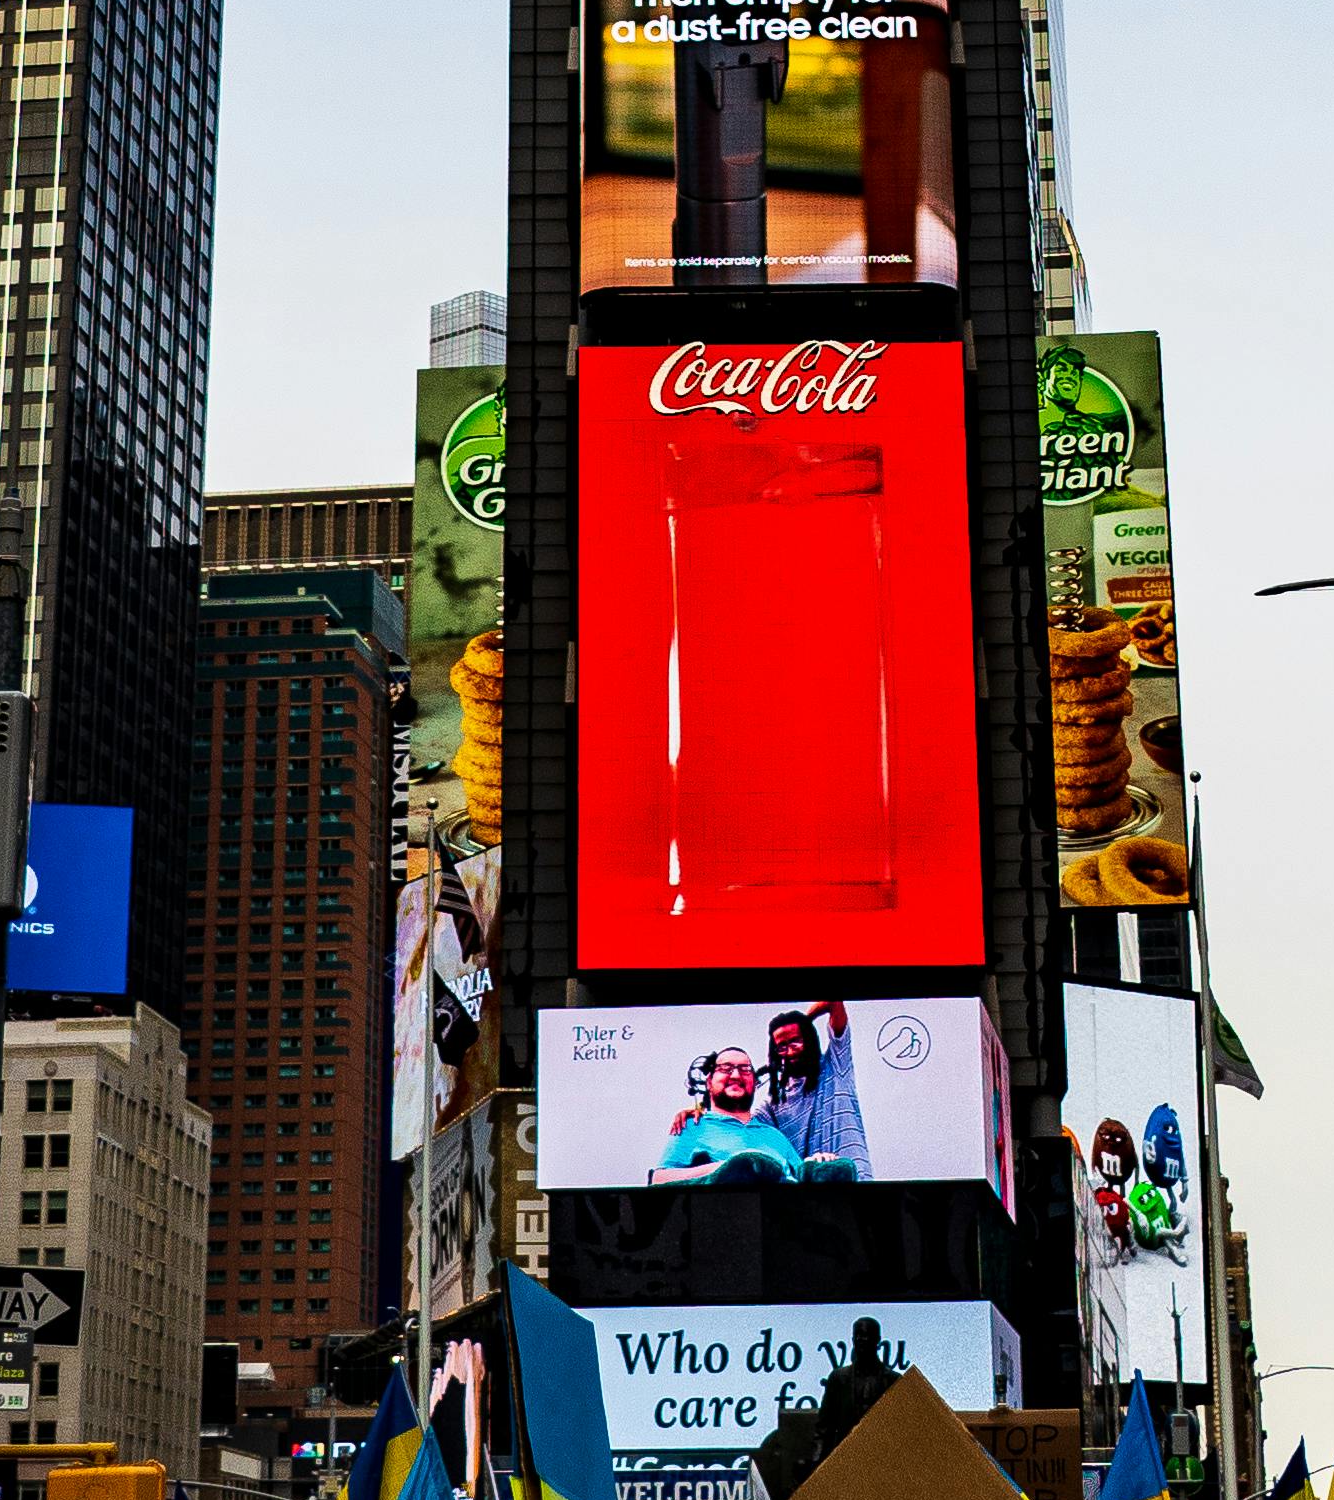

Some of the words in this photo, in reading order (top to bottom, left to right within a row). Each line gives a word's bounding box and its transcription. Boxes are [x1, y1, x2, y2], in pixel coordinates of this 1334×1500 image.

[611, 20, 637, 44] a
[642, 12, 814, 43] dust-free
[818, 9, 918, 40] clean
[678, 254, 703, 269] sold
[703, 254, 763, 271] separately
[763, 253, 779, 268] for
[781, 253, 821, 268] certain
[648, 338, 888, 416] Coca-Cola
[1114, 522, 1166, 538] Green
[572, 1025, 615, 1047] Tyler
[620, 1025, 635, 1042] &
[572, 1042, 618, 1062] Keith
[615, 1329, 730, 1376] Who
[745, 1328, 803, 1374] do
[653, 1395, 759, 1429] care
